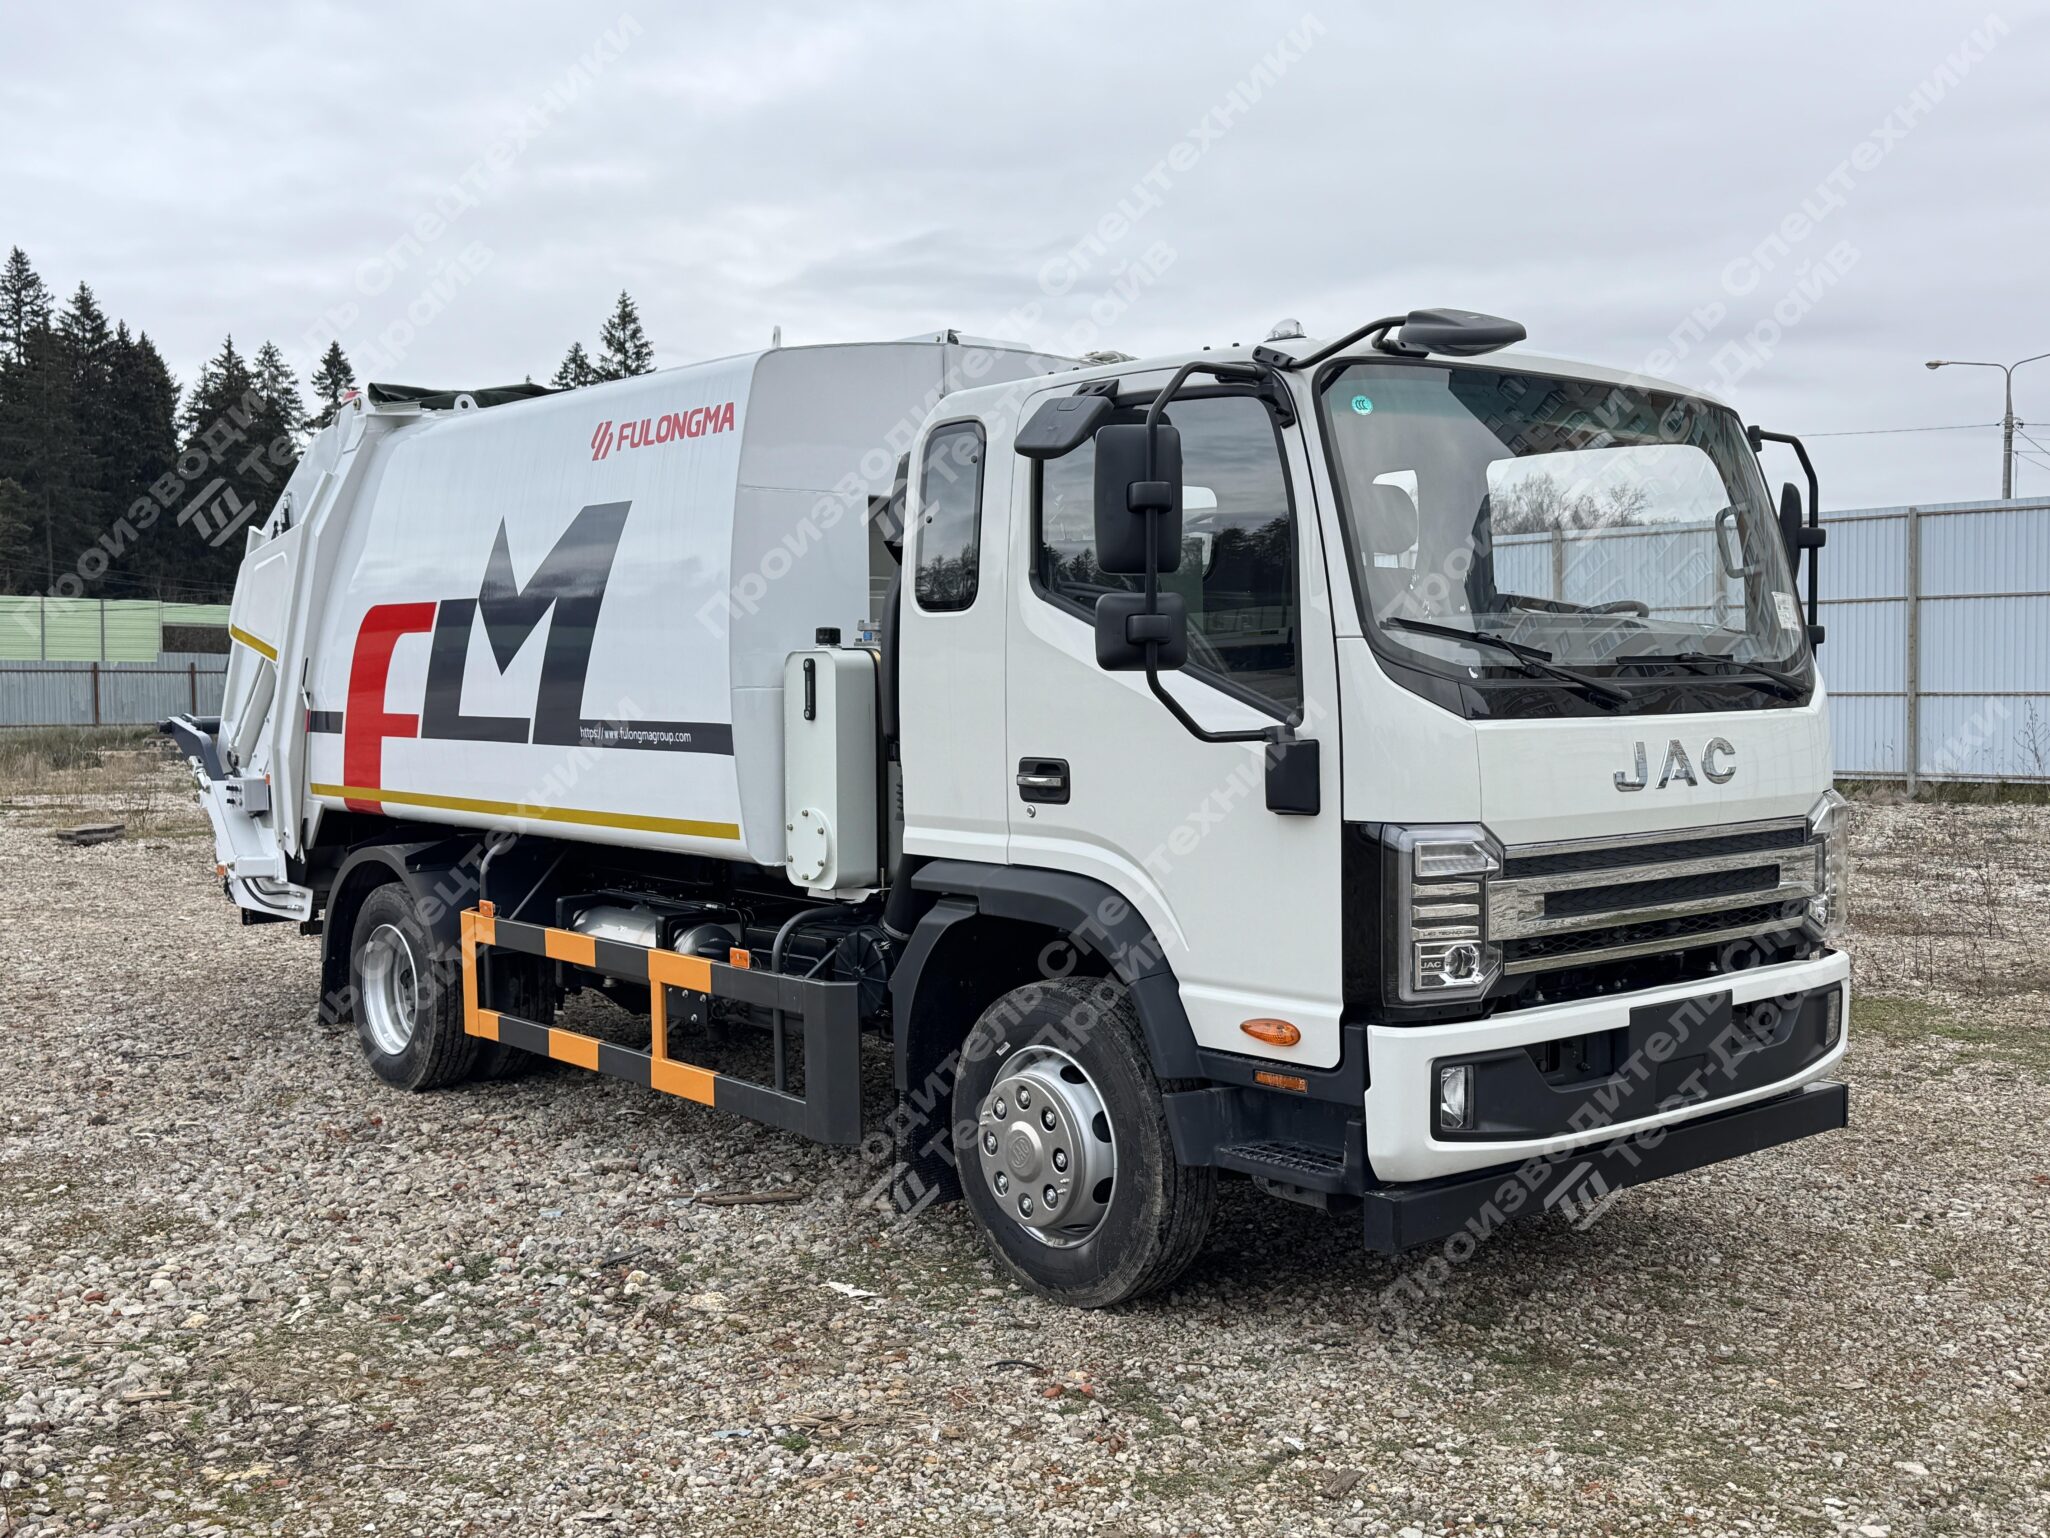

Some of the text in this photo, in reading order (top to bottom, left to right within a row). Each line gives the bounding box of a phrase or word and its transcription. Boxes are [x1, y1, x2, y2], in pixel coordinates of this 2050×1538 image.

[616, 402, 735, 451] FULONGMA
[1613, 736, 1737, 792] JAC
[1421, 961, 1442, 969] JAC
